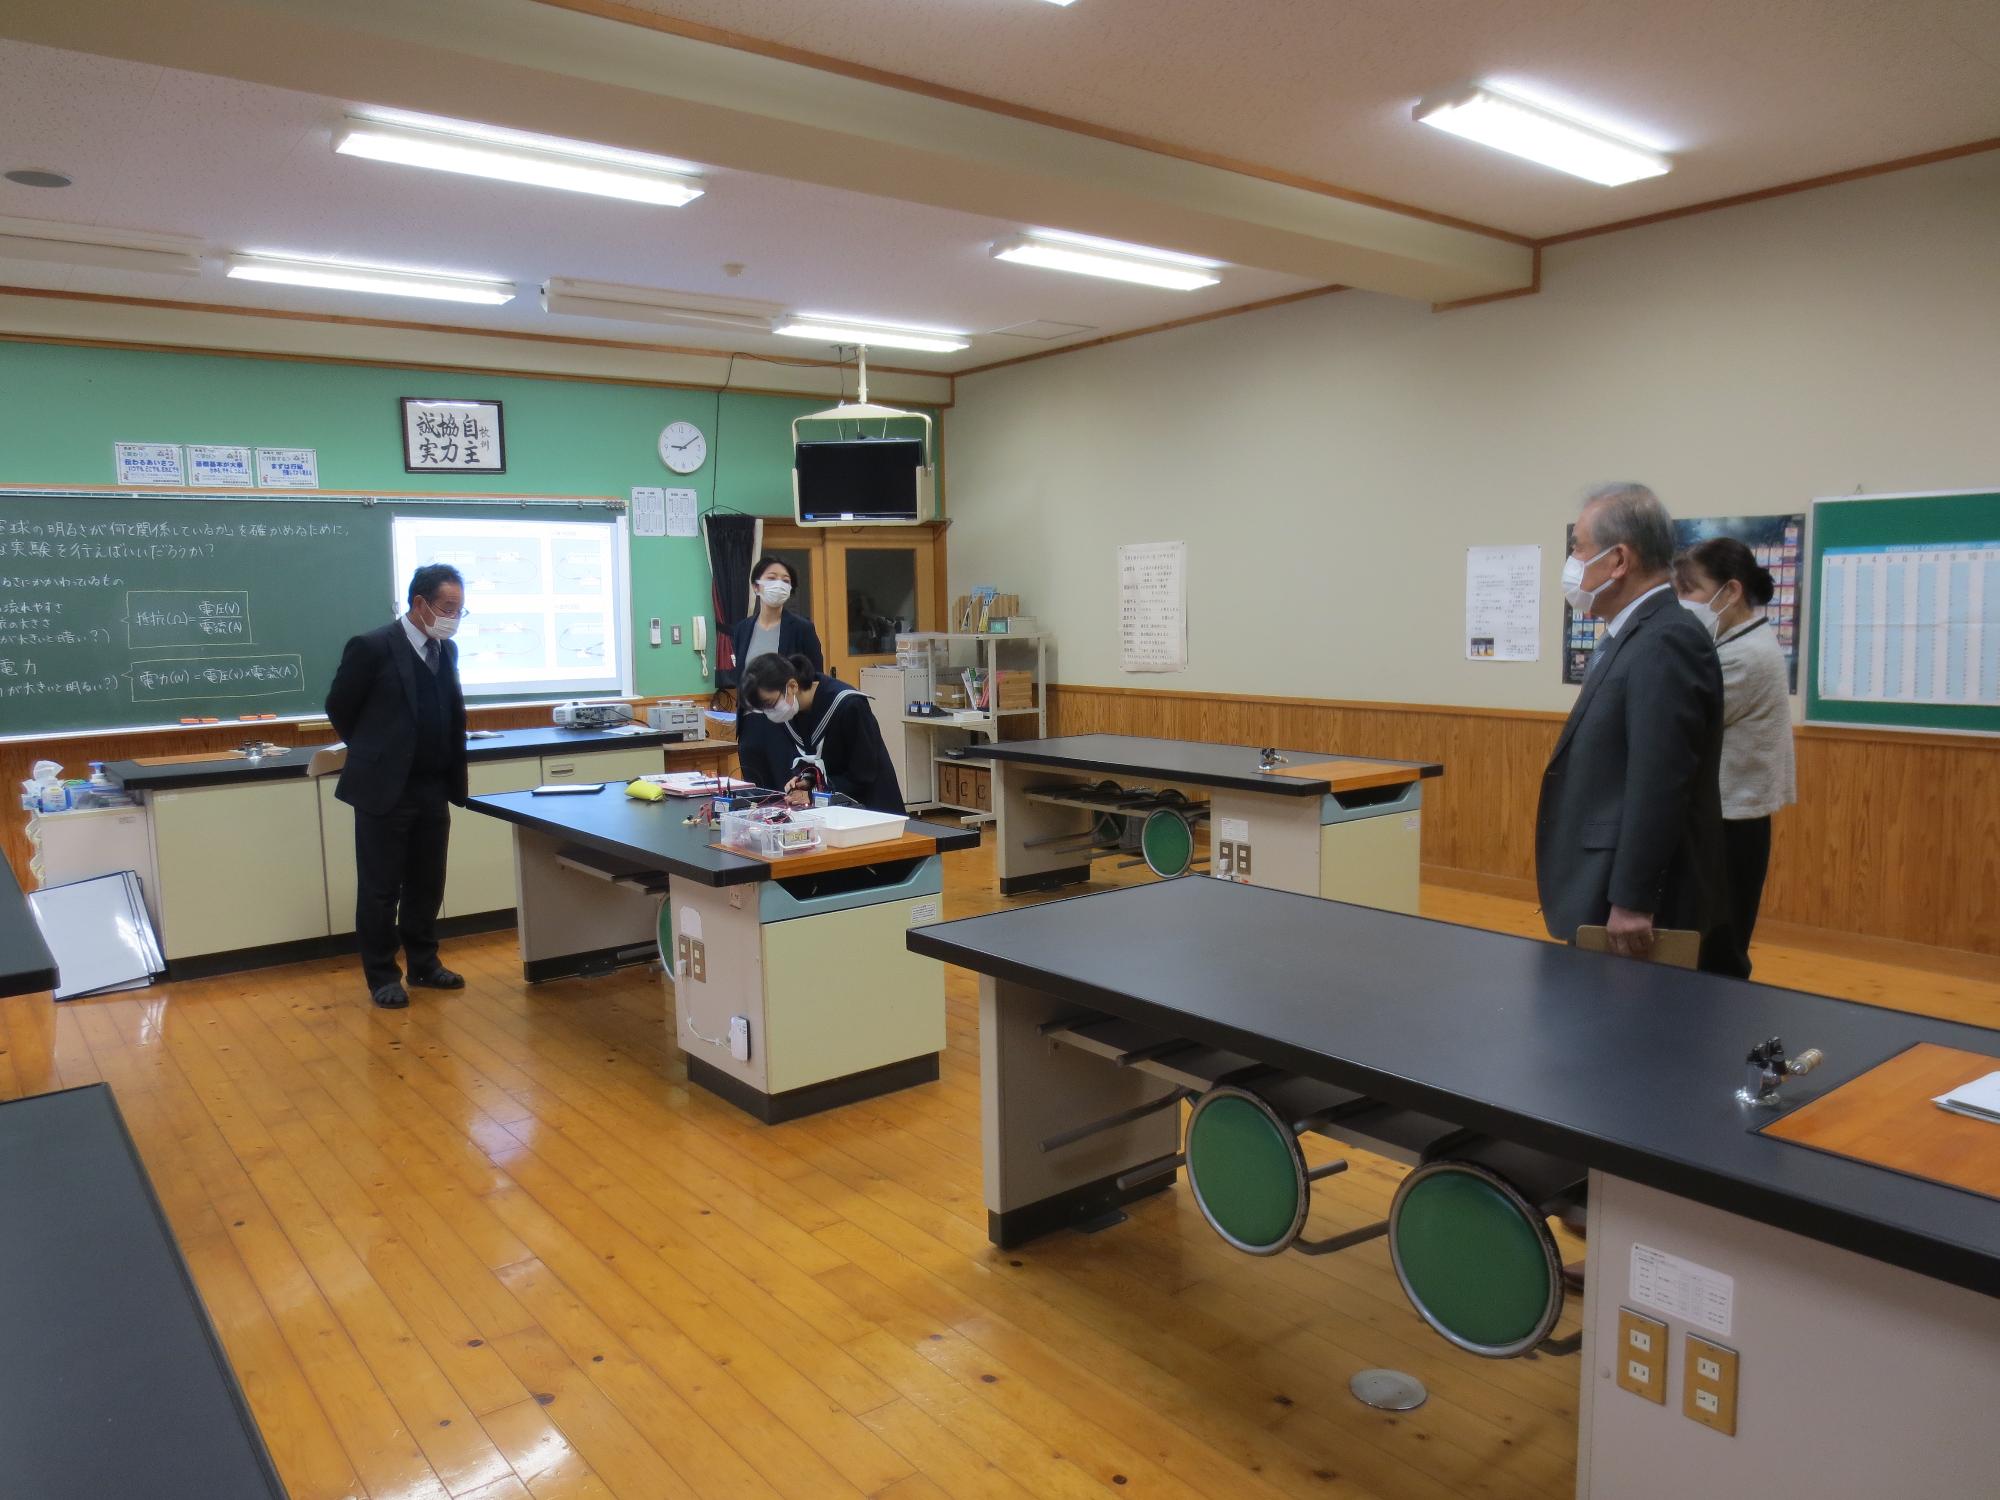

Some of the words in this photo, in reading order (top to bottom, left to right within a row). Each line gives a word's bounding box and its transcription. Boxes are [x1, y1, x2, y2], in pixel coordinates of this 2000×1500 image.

[417, 411, 440, 464] 誠実
[437, 413, 459, 463] 協力
[463, 413, 480, 464] 自主
